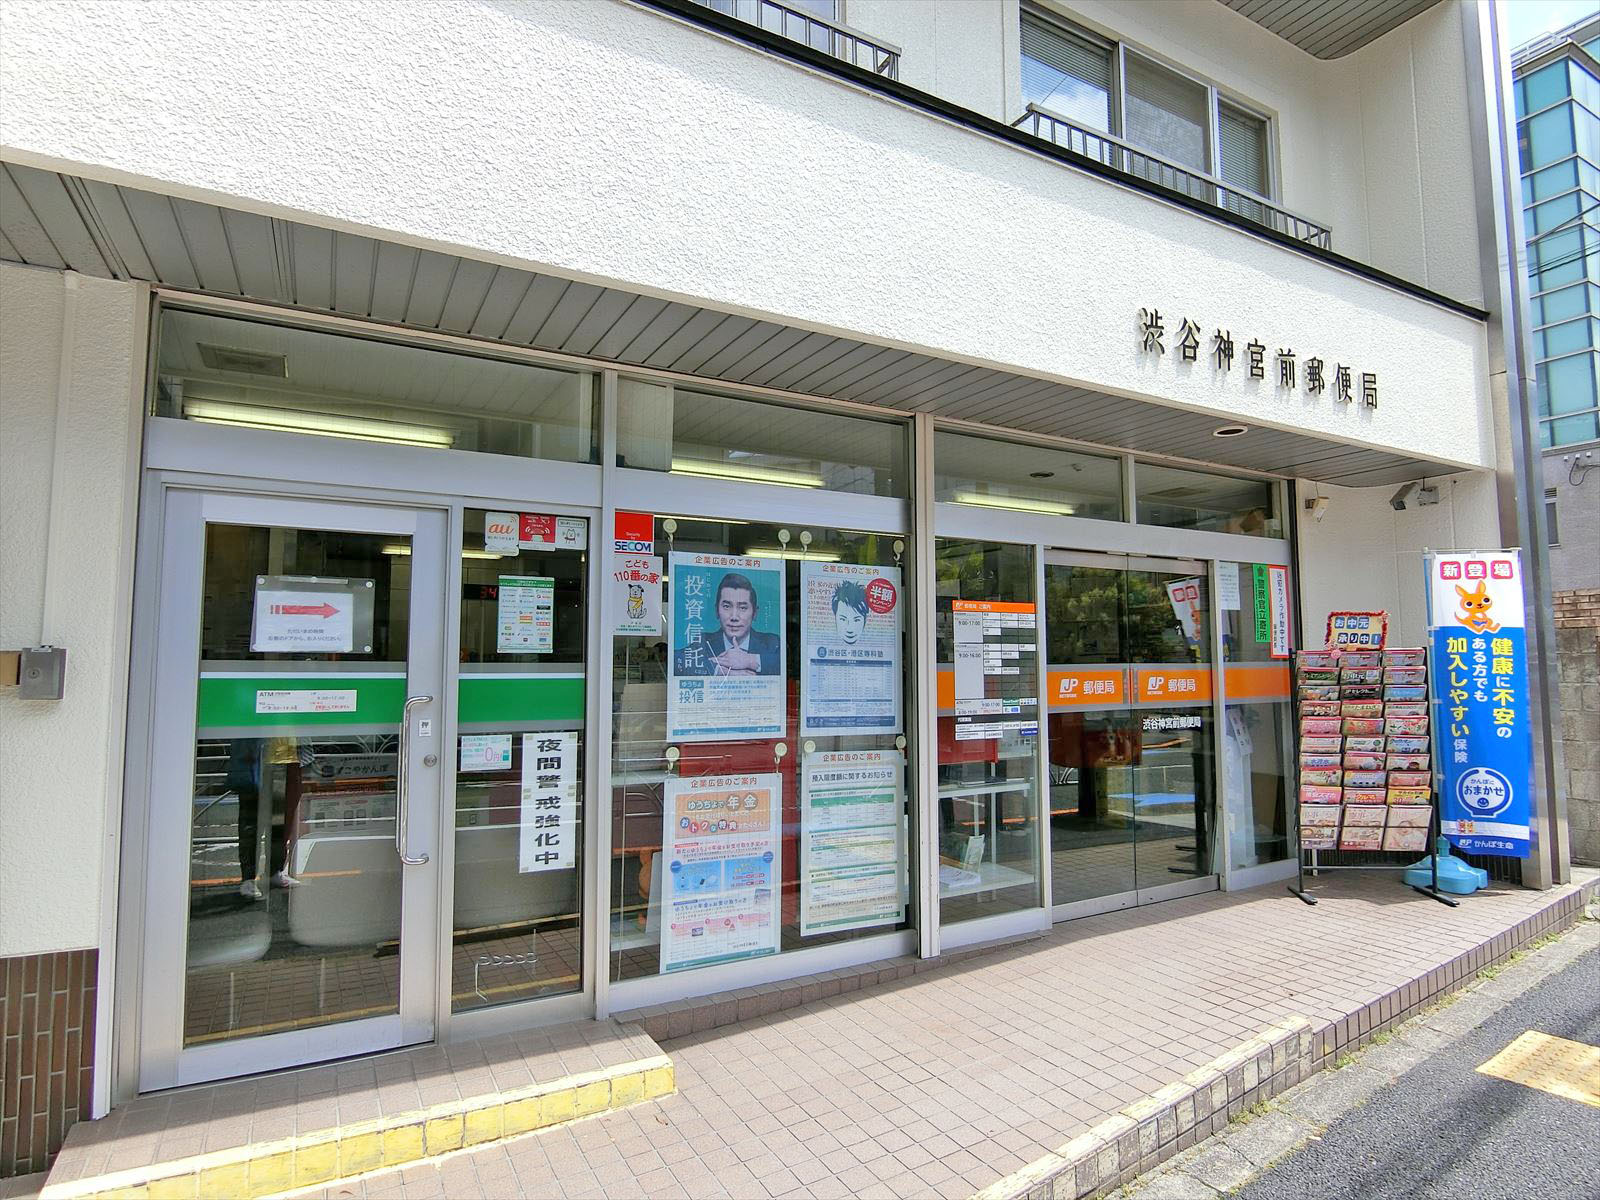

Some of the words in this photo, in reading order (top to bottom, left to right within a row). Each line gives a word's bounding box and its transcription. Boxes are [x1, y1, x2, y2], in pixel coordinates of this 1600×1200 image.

[1139, 307, 1378, 410] 渋谷神宮前郵便局
[488, 523, 514, 534] au
[614, 541, 651, 552] SECOM
[625, 559, 649, 569] こども
[695, 556, 761, 567] 企業広告のご案内
[823, 564, 880, 575] 企業広告のご案内
[1442, 562, 1513, 578] 新登場
[614, 570, 660, 584] 110番の家
[870, 585, 894, 602] 半額
[1257, 578, 1268, 641] 警察官立寄所
[684, 574, 705, 669] 投資信託
[1335, 617, 1369, 629] お中元
[1471, 637, 1488, 703] ある方でも
[1083, 680, 1115, 694] 郵便局
[1167, 679, 1196, 692] 郵便局
[1490, 637, 1515, 739] 健康に不安の
[679, 690, 704, 704] 投信
[1446, 637, 1470, 763] 加入しやすい保険
[1143, 715, 1202, 730] 渋谷神宮前郵便局
[823, 753, 882, 762] 企業広告のご案内
[691, 777, 758, 788] 企業広告のご案内
[1464, 785, 1504, 796] おまかせ
[534, 738, 563, 865] 夜間警戒強化中
[1474, 840, 1514, 849] かんぽ生命
